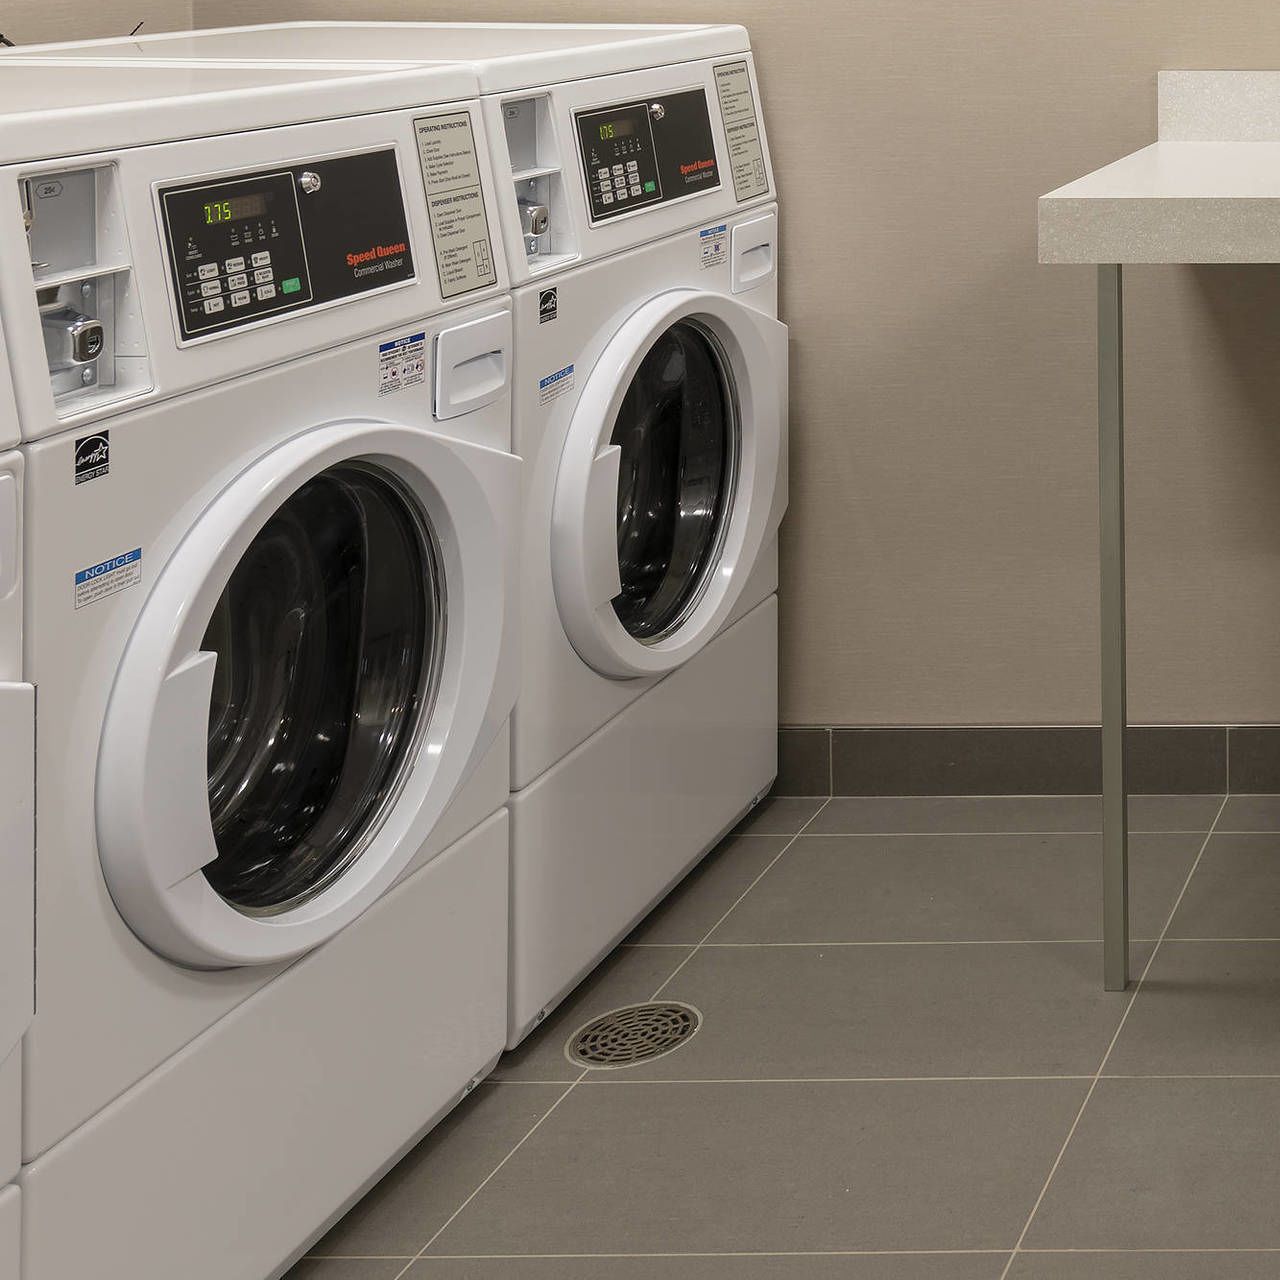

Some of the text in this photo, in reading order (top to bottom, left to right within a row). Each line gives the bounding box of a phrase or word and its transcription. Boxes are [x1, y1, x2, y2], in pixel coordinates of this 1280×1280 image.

[347, 243, 406, 267] Speed Queen
[84, 552, 134, 580] NOTICE
